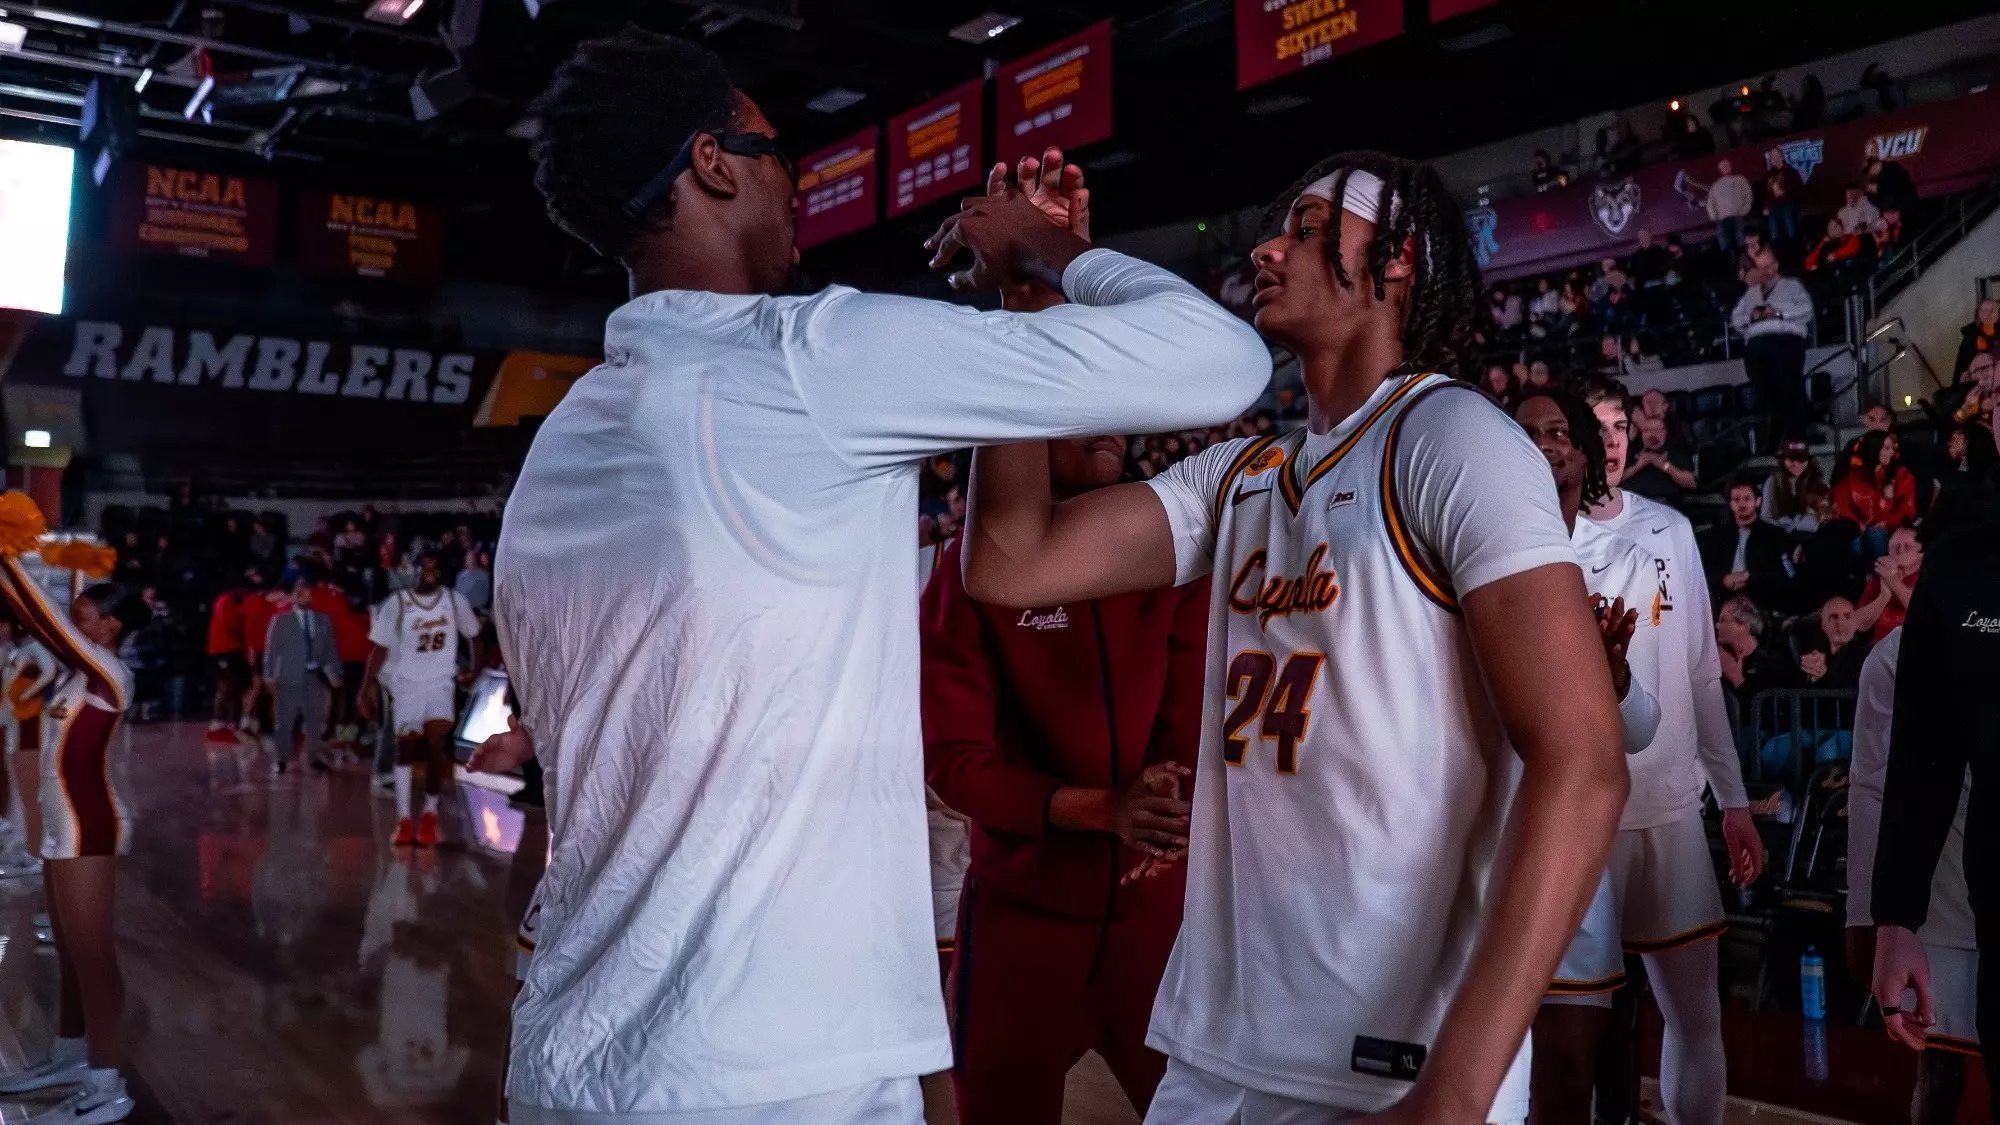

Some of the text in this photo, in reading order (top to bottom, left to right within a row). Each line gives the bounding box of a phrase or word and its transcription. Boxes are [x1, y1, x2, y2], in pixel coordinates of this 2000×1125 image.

[1275, 9, 1358, 60] SIXTEEN
[1875, 126, 1929, 161] VCU
[147, 164, 247, 208] NCAA
[330, 192, 418, 230] NCAA
[62, 320, 476, 405] RAMBLERS
[1228, 541, 1340, 635] Loyola
[1016, 605, 1069, 630] Loyola
[1961, 610, 2000, 633] Loyo
[1223, 651, 1328, 775] 24
[1401, 1053, 1418, 1071] XL
